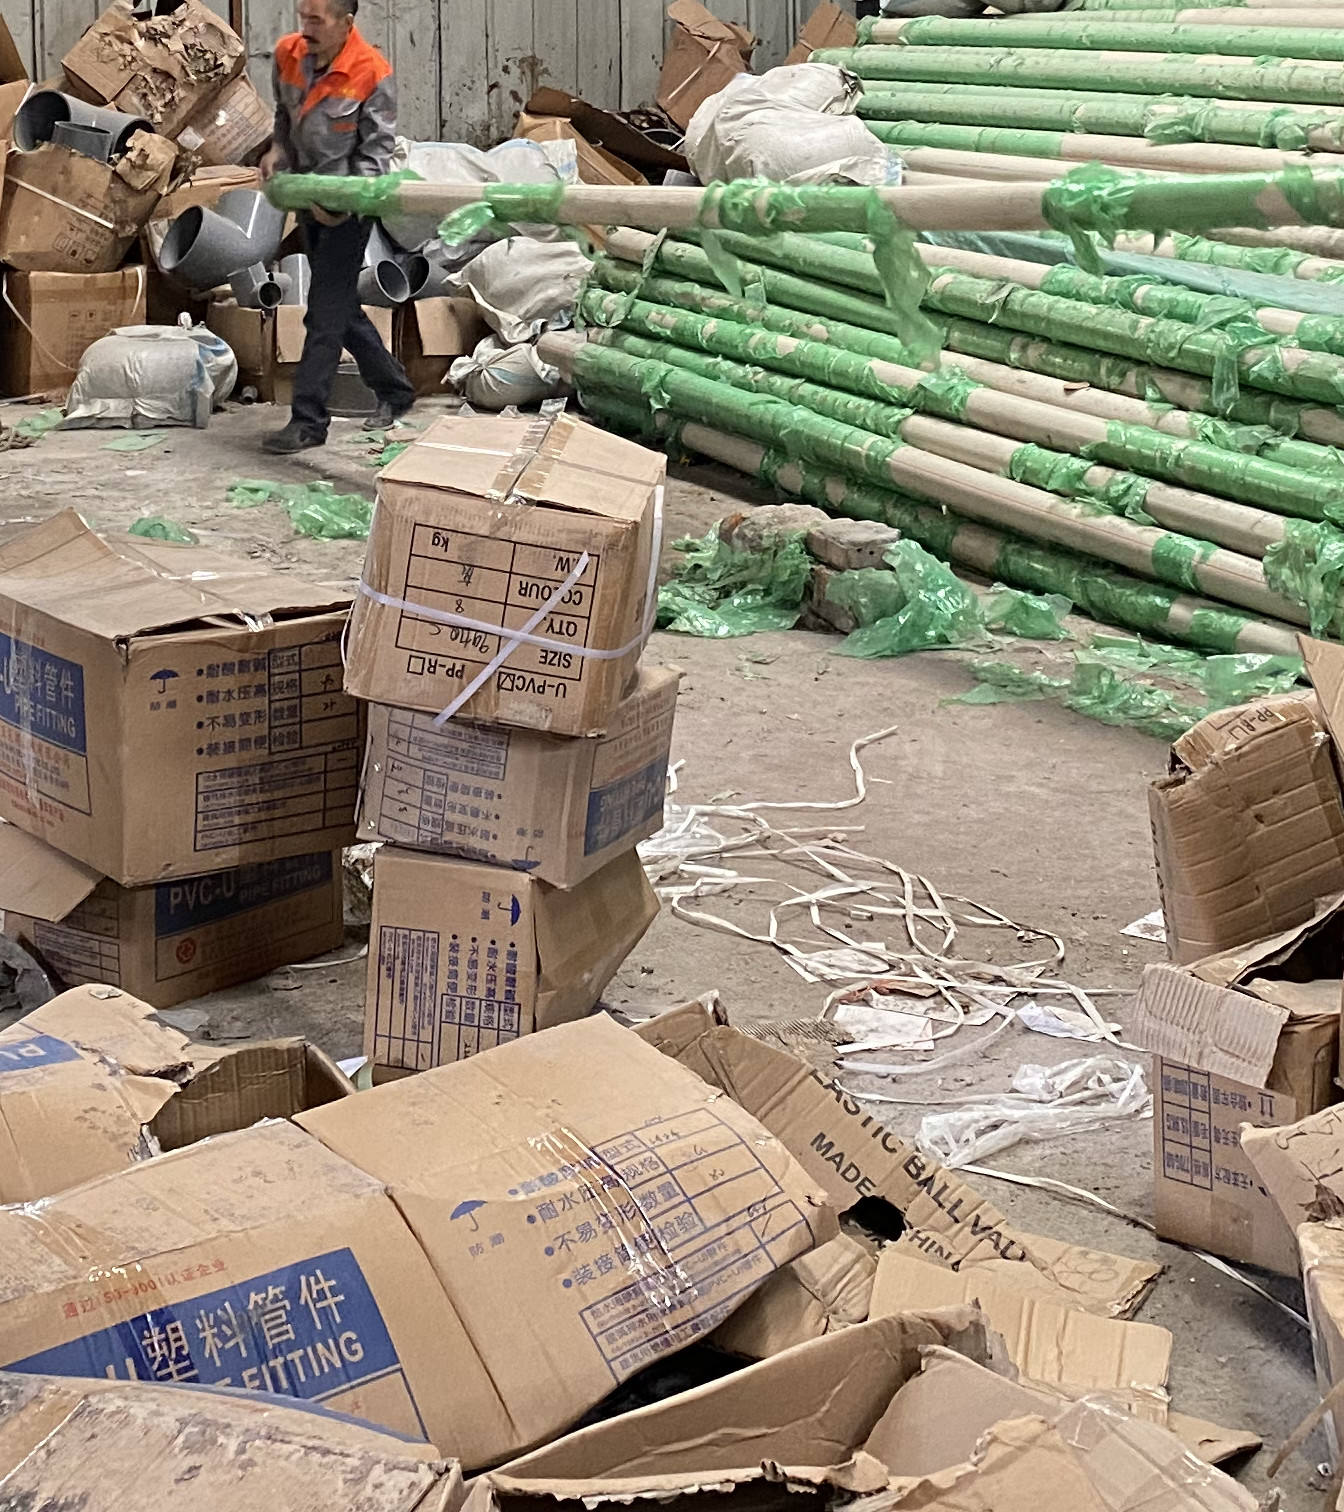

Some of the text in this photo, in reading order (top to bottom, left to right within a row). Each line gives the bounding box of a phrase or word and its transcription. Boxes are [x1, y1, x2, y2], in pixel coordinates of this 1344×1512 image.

[432, 531, 450, 552] kg
[519, 580, 583, 606] COOUR
[543, 617, 578, 637] QTY.
[427, 658, 466, 679] PP-R
[539, 649, 573, 668] SIZE
[515, 677, 567, 698] U-PVC
[36, 706, 76, 739] FITTING
[621, 1156, 660, 1182] 规格
[809, 1131, 877, 1197] MADE
[903, 1154, 965, 1224] BALL
[140, 1266, 346, 1383] 塑料管件
